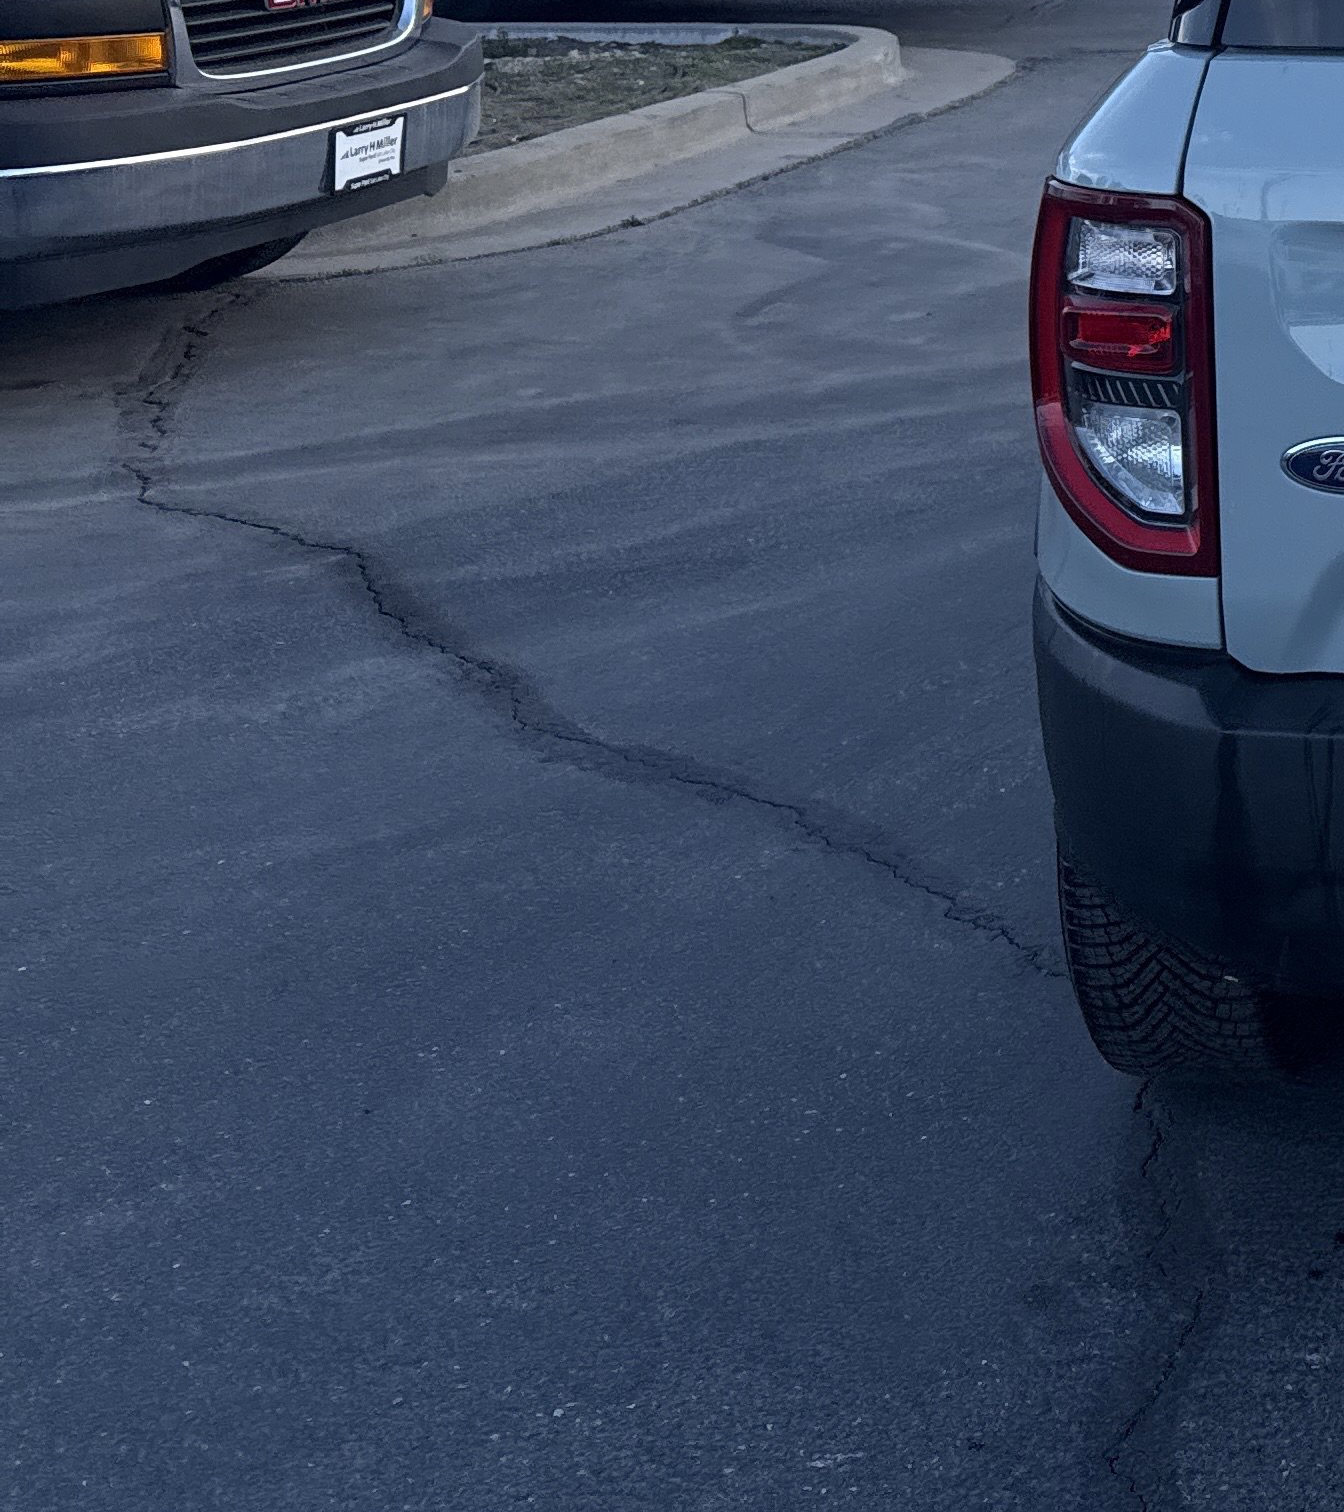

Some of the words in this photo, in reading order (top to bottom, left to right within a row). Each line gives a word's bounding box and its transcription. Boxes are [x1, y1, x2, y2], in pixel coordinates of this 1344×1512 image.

[349, 145, 369, 158] Larry
[369, 140, 376, 152] H
[376, 135, 398, 151] Miller
